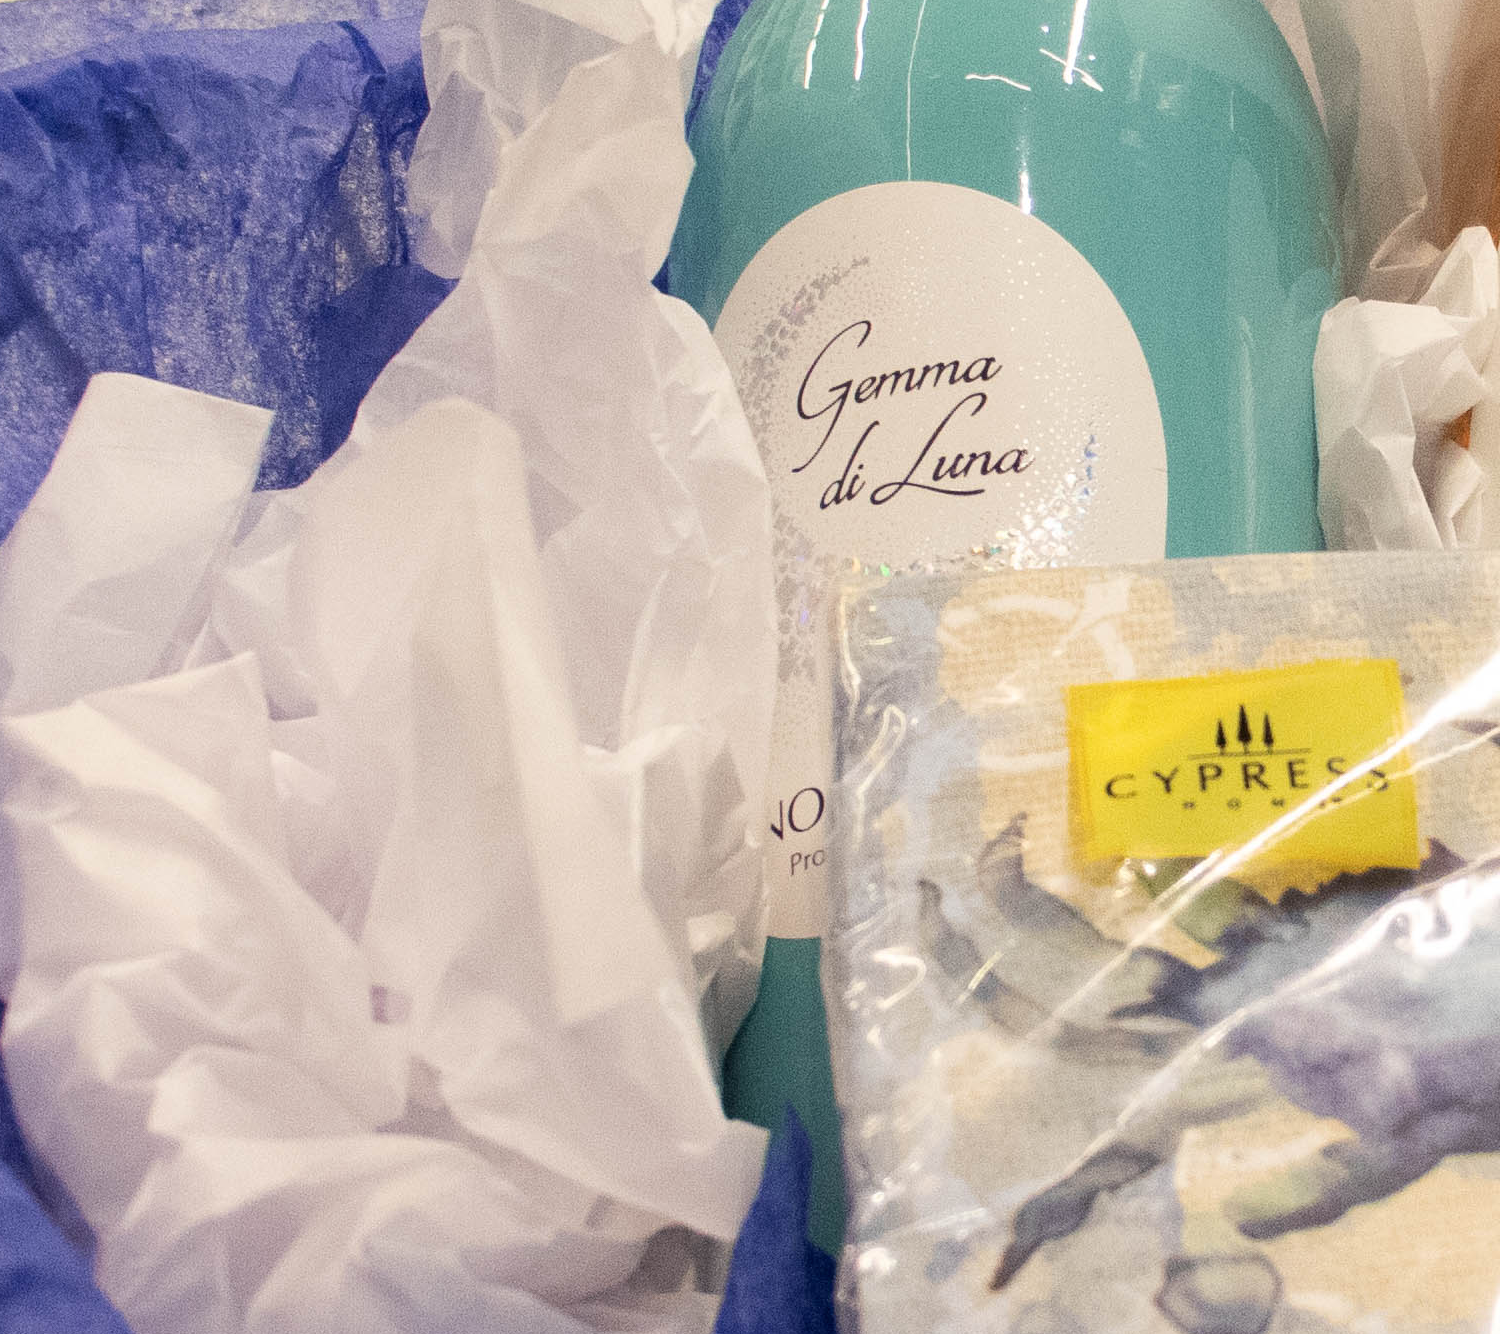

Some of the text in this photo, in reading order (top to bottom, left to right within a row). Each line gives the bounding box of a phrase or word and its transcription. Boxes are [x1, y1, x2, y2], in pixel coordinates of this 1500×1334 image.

[791, 320, 1003, 473] Gemma
[819, 392, 1037, 510] di Luna
